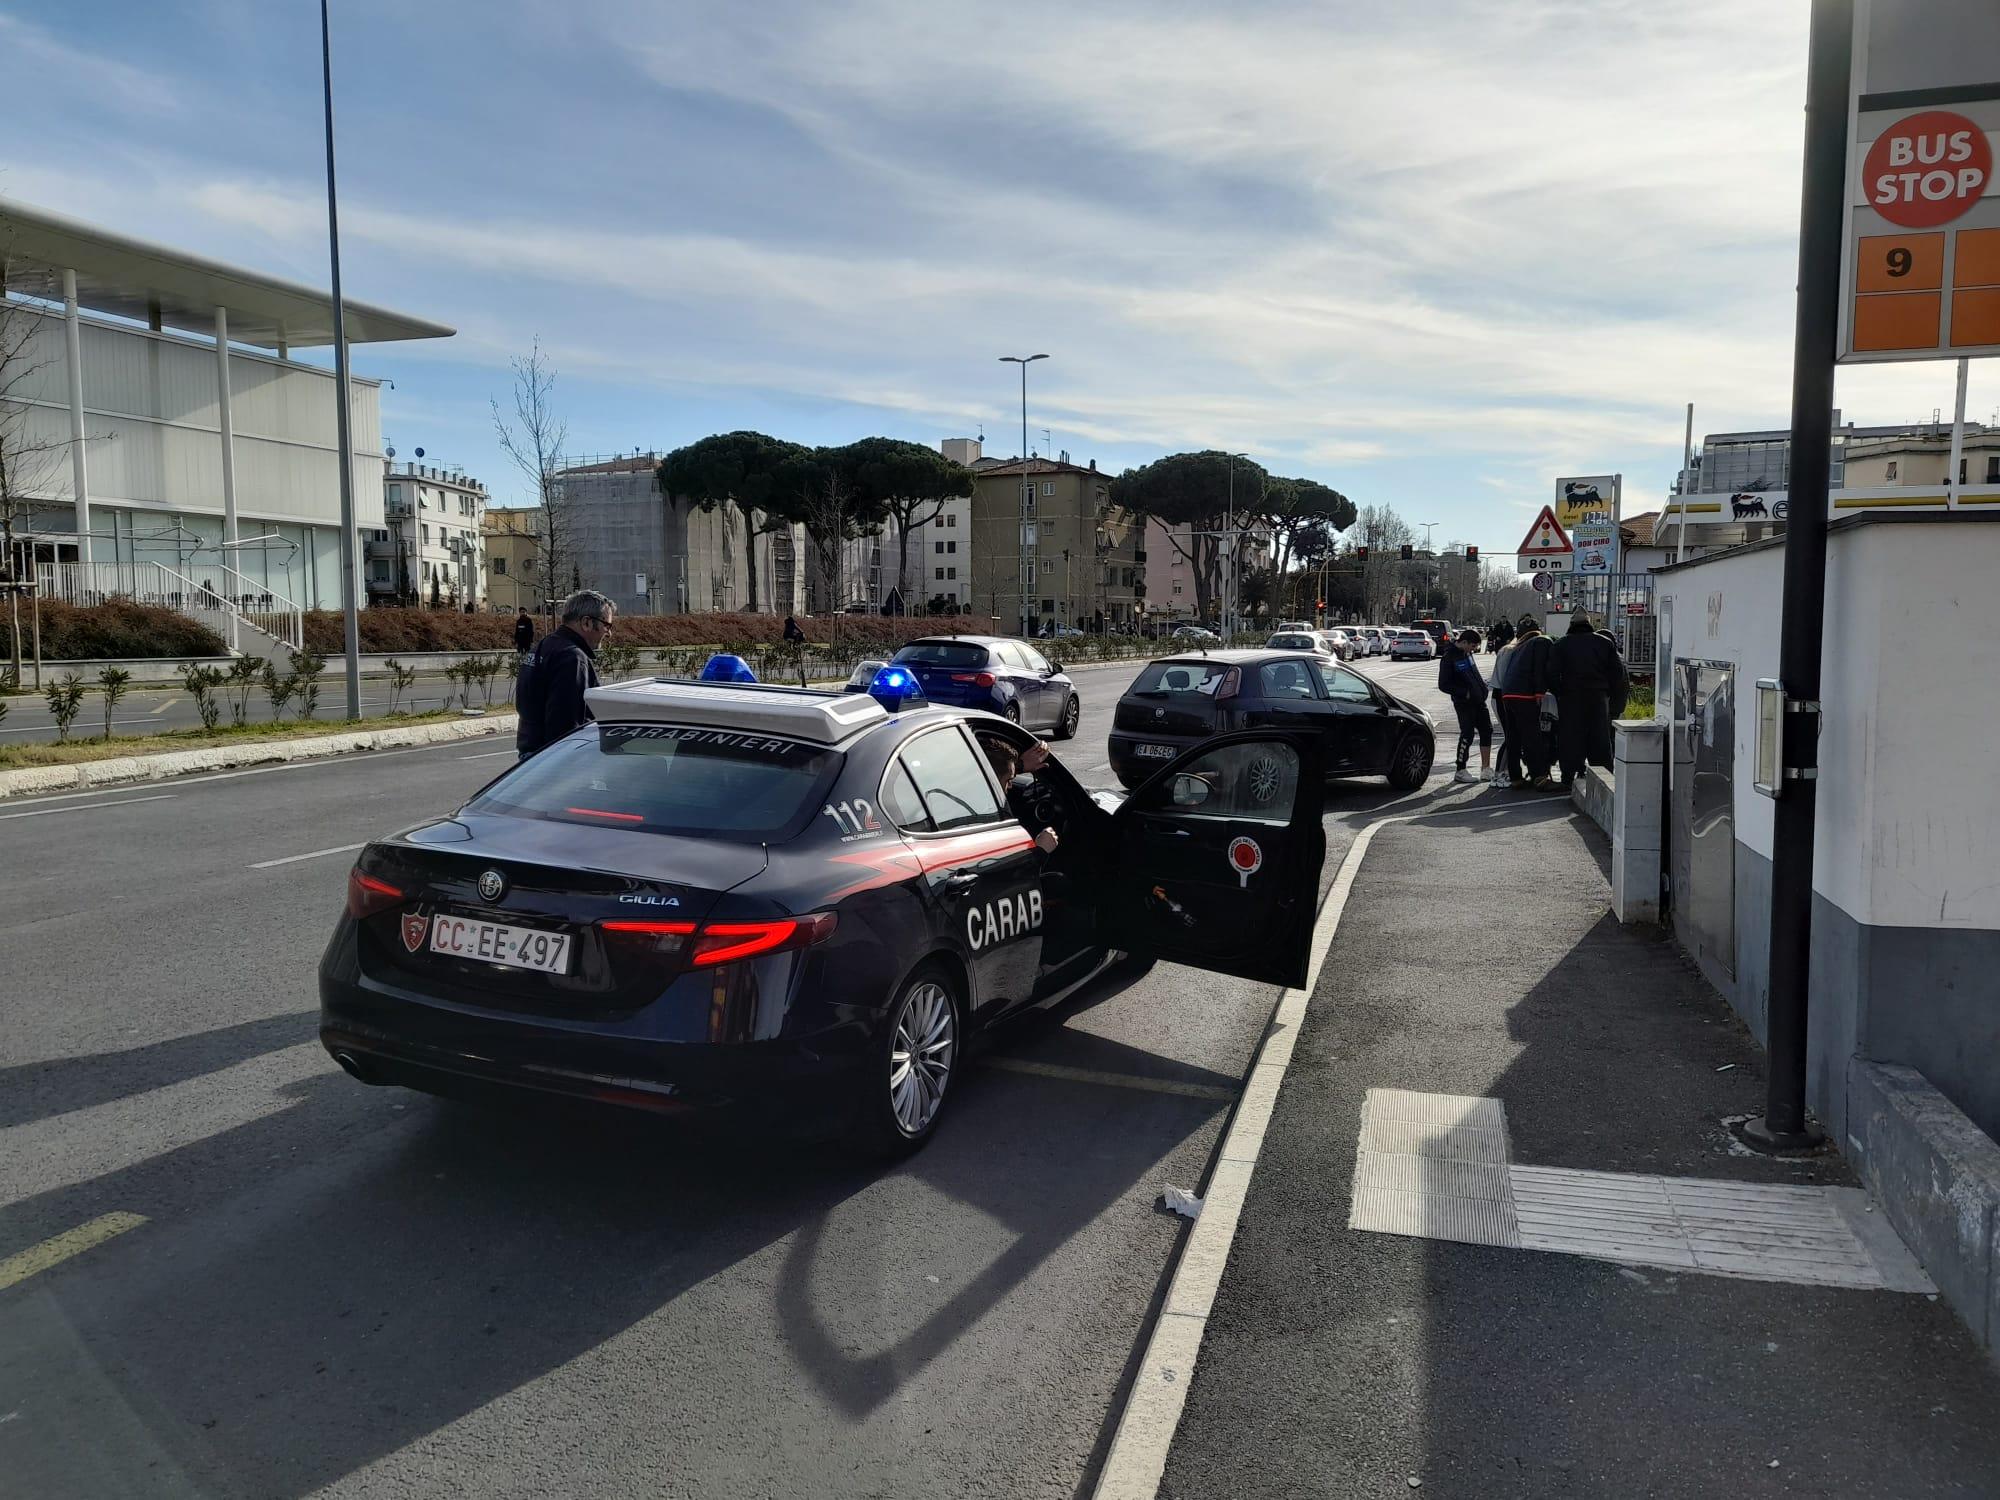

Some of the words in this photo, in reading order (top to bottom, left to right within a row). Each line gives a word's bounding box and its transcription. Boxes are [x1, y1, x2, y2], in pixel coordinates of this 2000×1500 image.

[1889, 130, 1973, 167] BUS
[1875, 168, 1983, 204] STOP
[1886, 247, 1912, 277] 9
[1577, 540, 1592, 548] DON
[1529, 558, 1548, 569] 80
[1551, 560, 1562, 569] m
[605, 727, 796, 754] CARABINIERI
[823, 798, 881, 834] 112
[618, 895, 680, 907] GIULIA
[967, 889, 1043, 951] CARAB
[435, 919, 466, 951] CC
[477, 925, 510, 960] EE
[516, 933, 565, 968] 497
